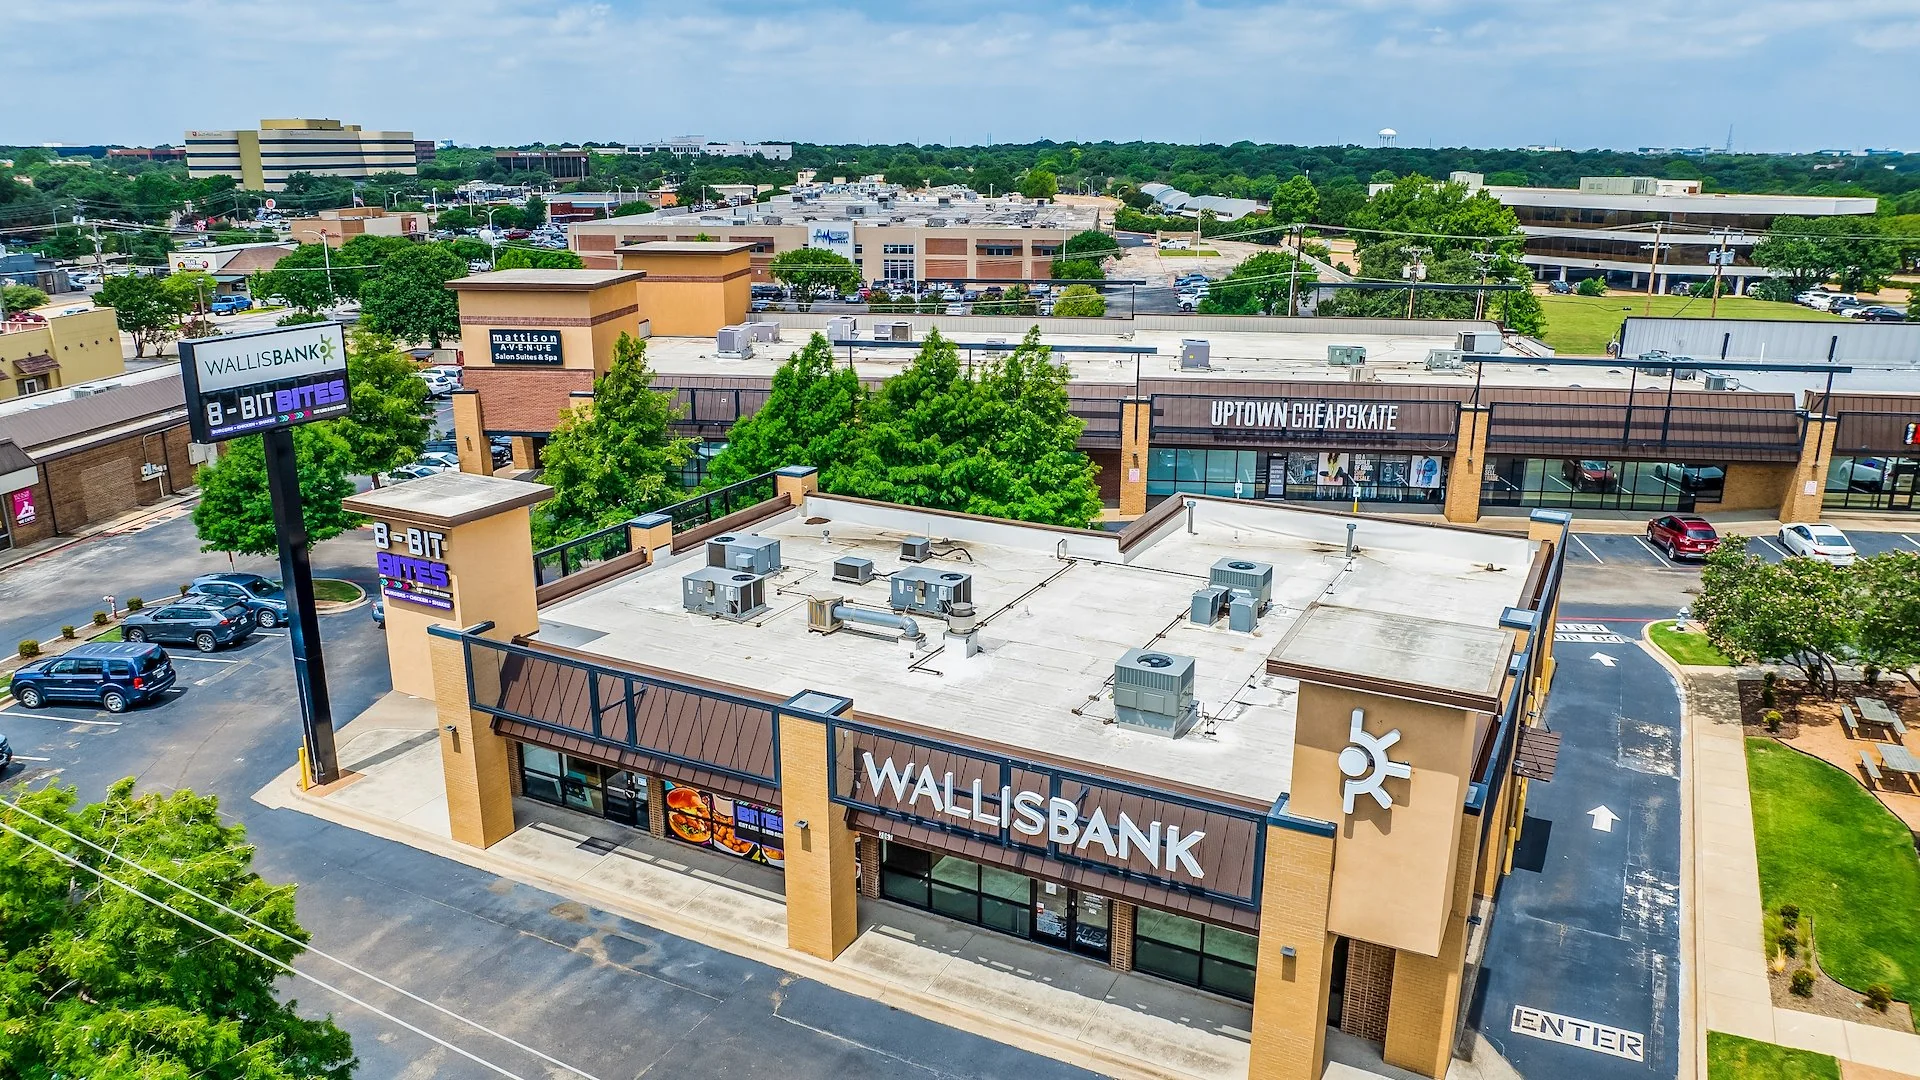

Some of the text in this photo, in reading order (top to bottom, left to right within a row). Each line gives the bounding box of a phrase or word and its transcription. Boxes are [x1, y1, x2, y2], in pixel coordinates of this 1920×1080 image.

[492, 333, 557, 342] mattison
[205, 343, 320, 376] WALLISBANK
[516, 353, 537, 361] Suites
[544, 354, 558, 362] Spa
[275, 379, 346, 413] BITES
[1211, 400, 1399, 430] UPTOWN CHEAPSKATE
[377, 552, 448, 588] BITES
[862, 752, 1206, 879] WALLISBANK
[1514, 1008, 1641, 1057] ENTER
